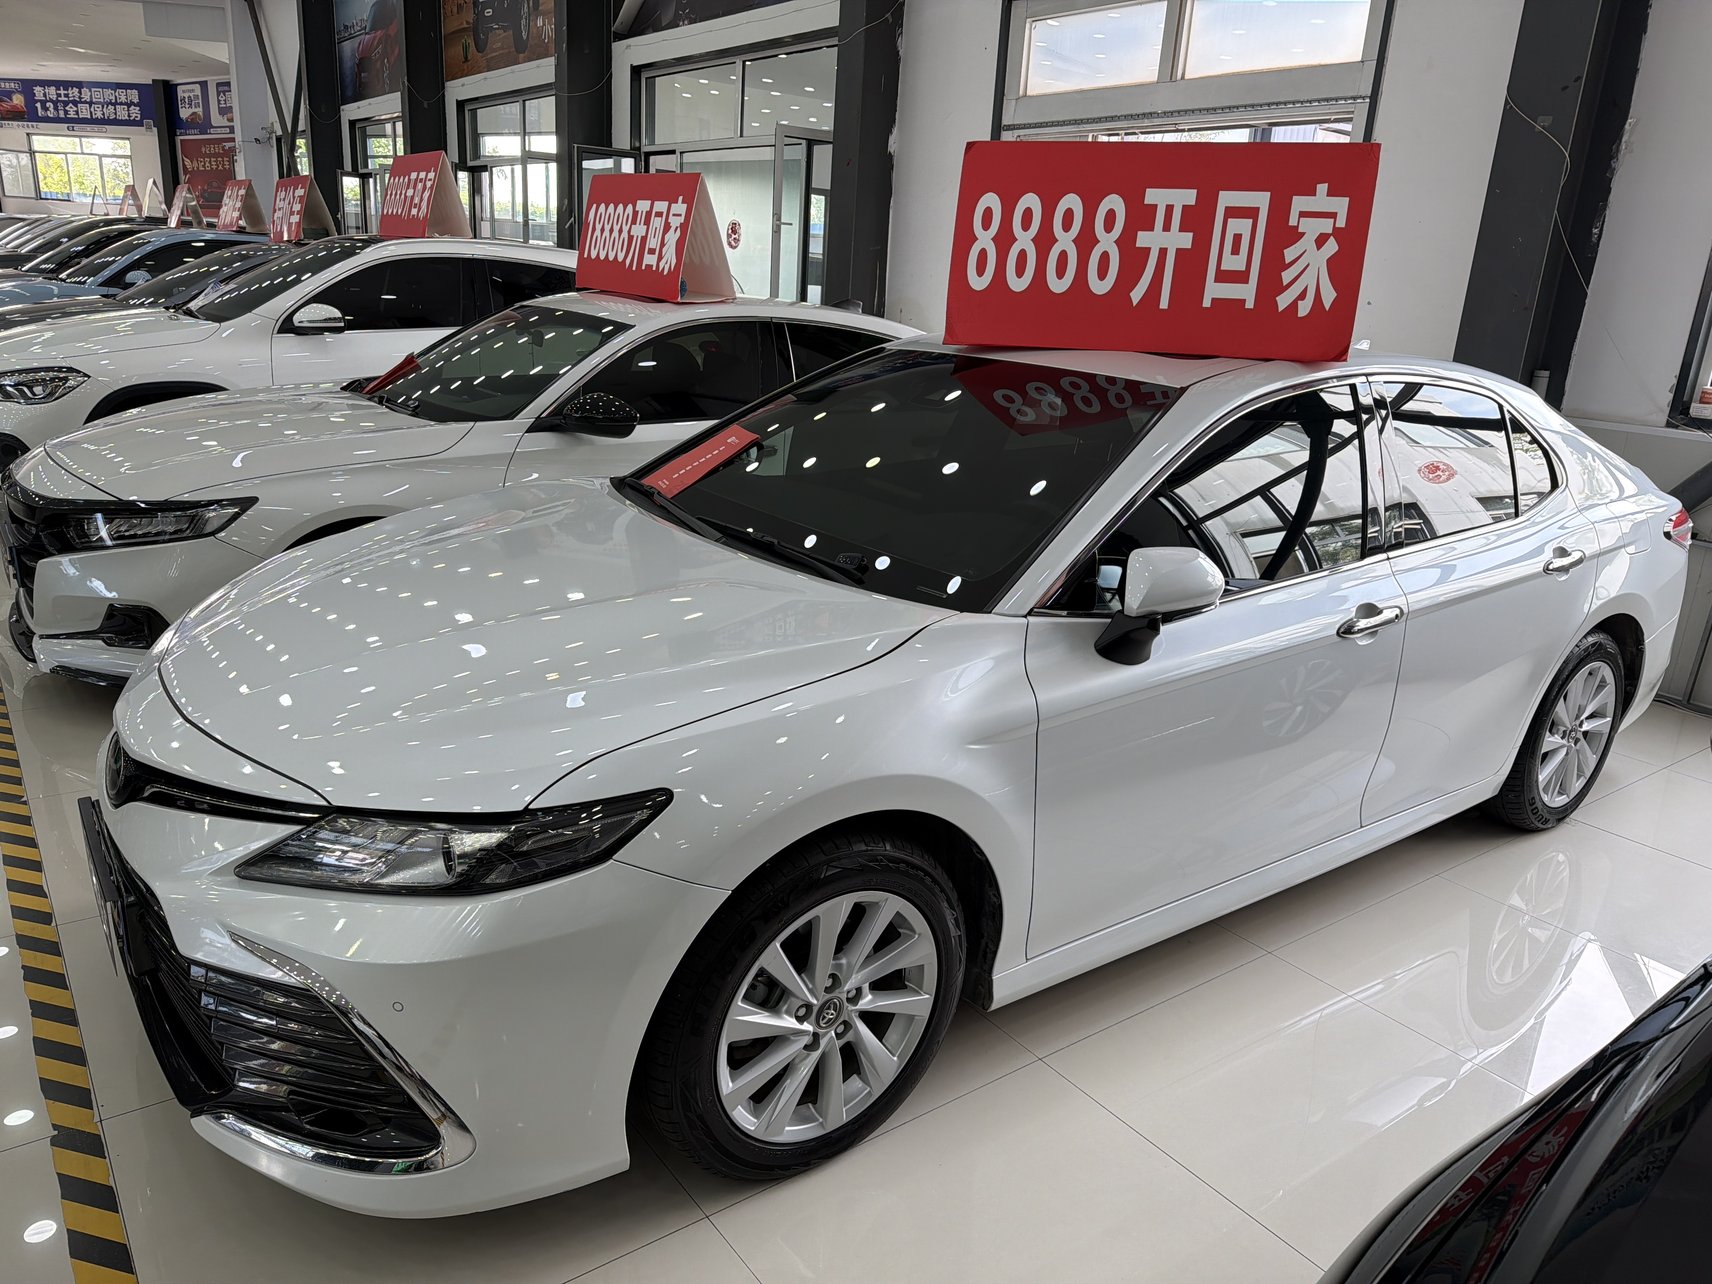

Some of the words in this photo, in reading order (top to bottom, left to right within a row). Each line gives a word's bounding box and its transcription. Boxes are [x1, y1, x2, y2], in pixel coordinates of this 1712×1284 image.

[32, 86, 140, 104] 查博士终身回购保障
[583, 195, 688, 276] 18888开回家
[966, 183, 1351, 318] 8888开回家
